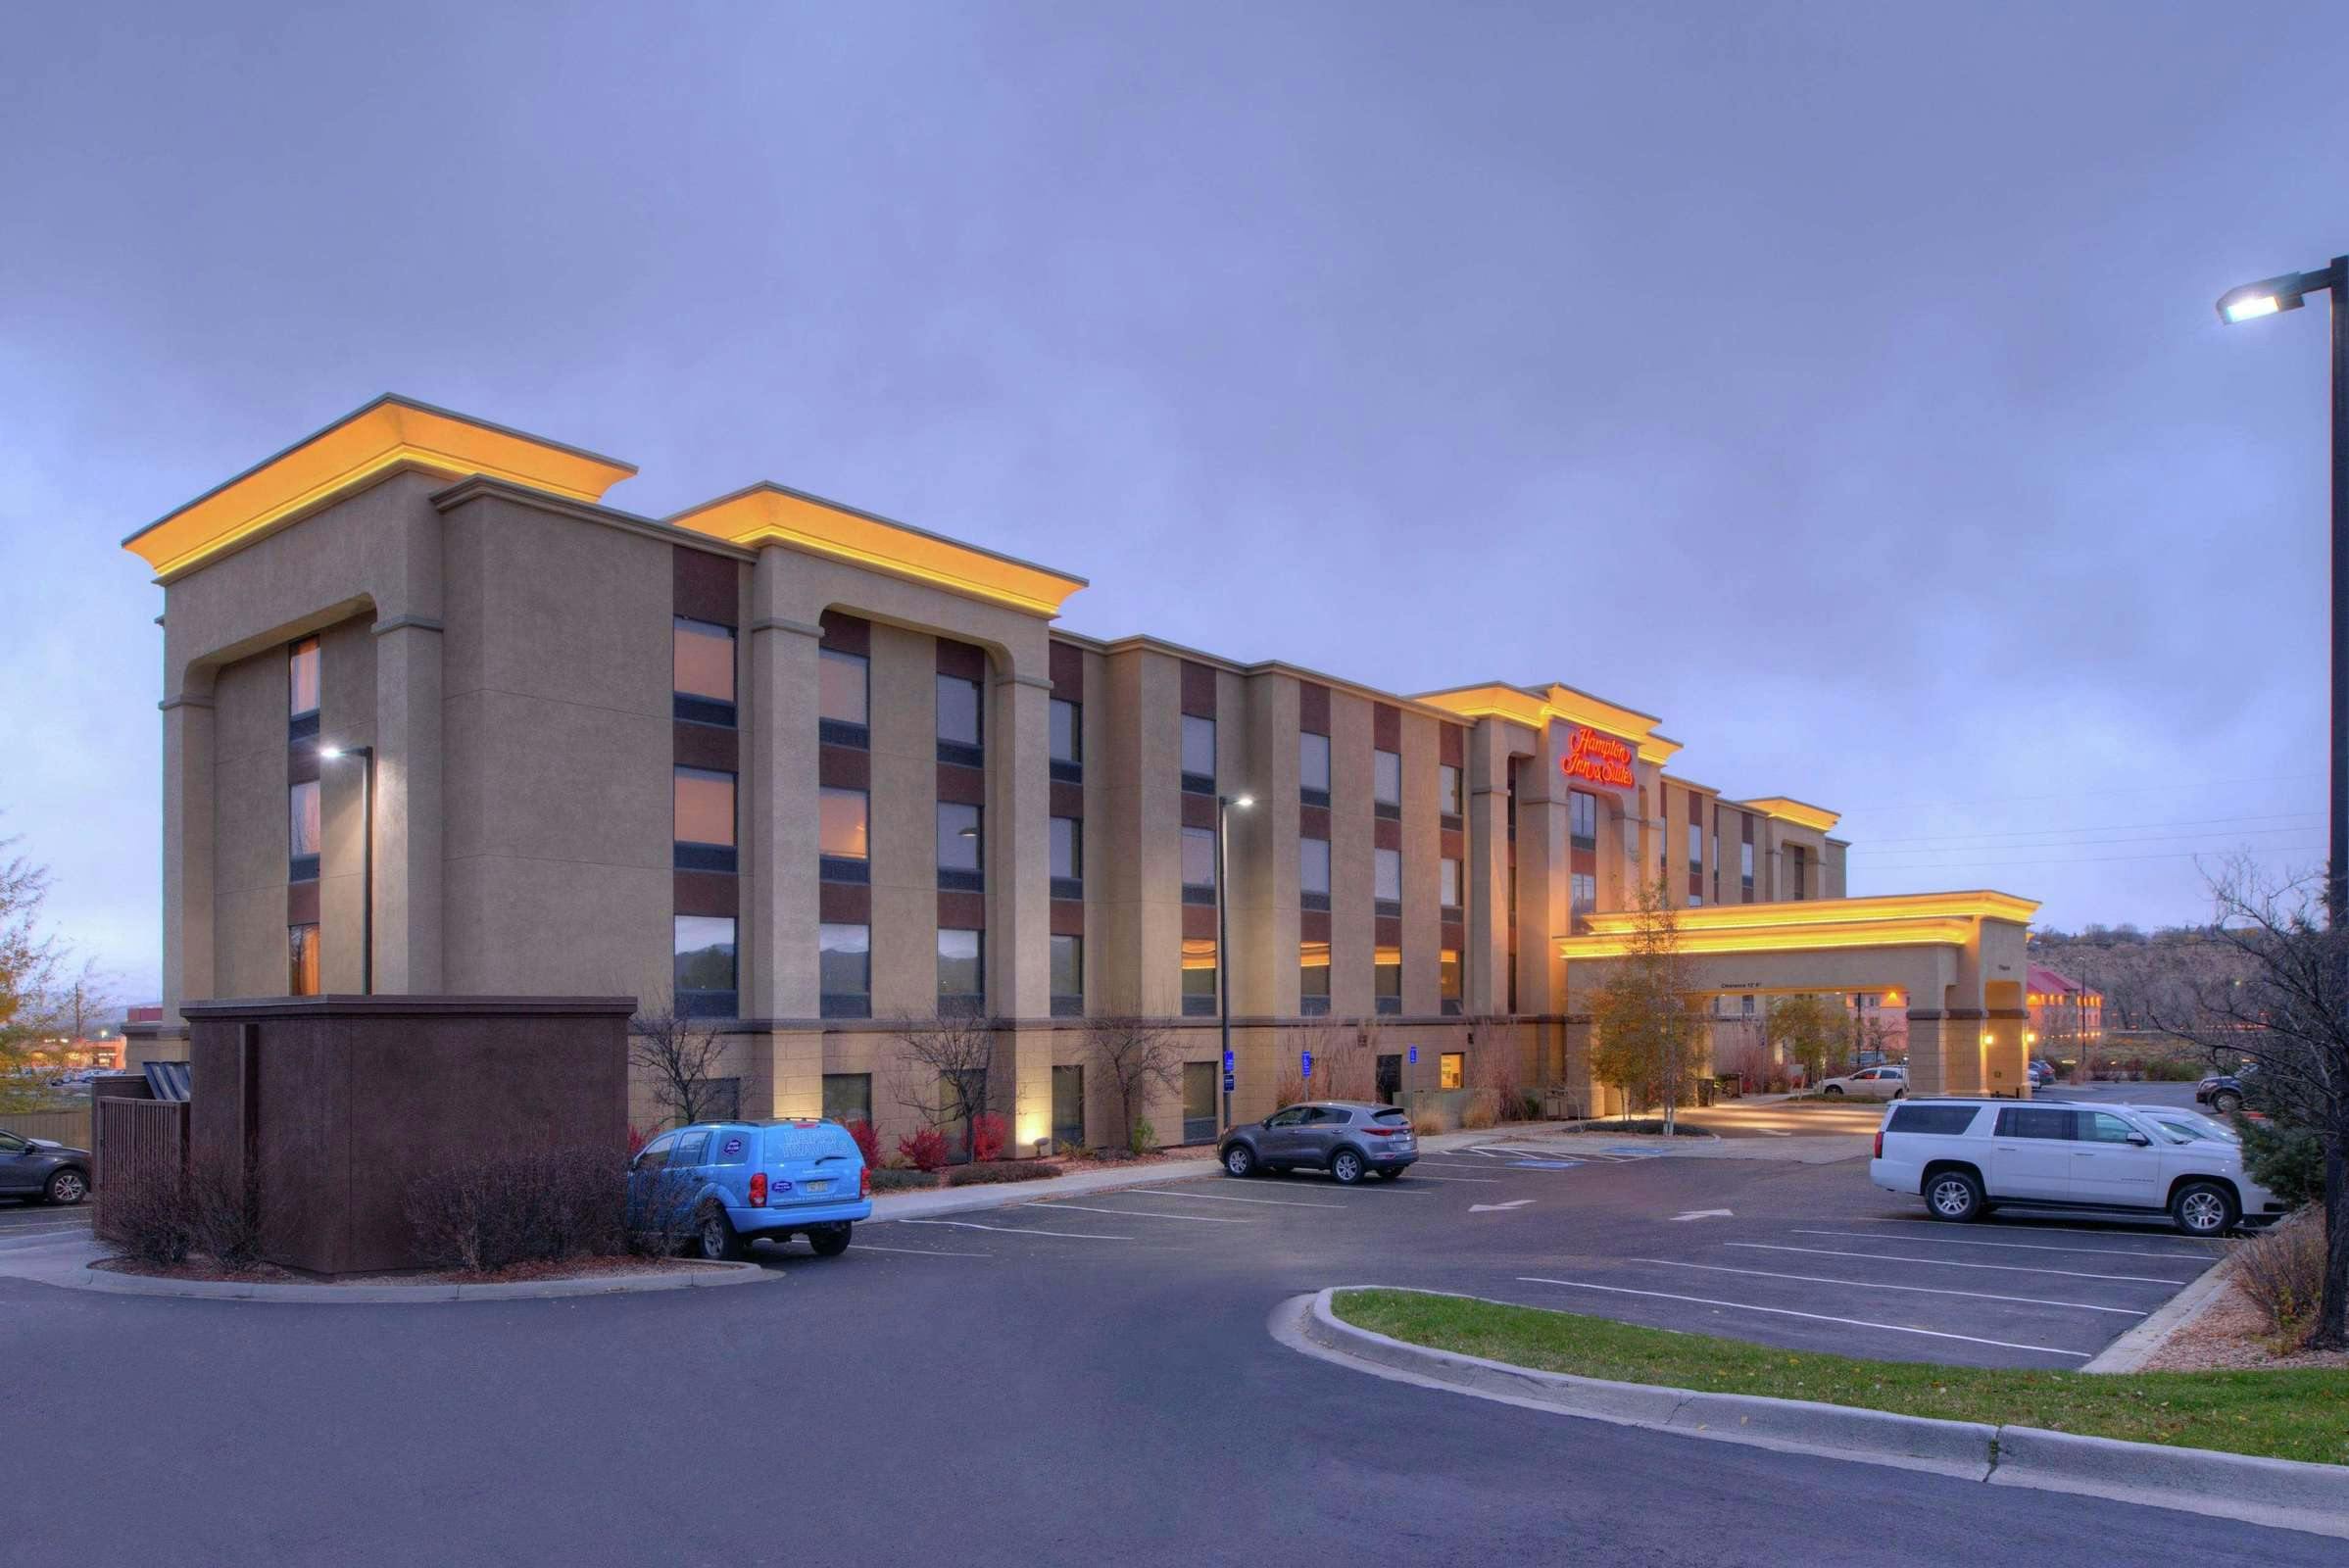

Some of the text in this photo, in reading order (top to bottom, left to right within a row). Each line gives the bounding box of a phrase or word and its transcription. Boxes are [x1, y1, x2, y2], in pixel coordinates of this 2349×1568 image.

[1570, 727, 1632, 764] Hampton
[1562, 752, 1594, 779] Inn
[1602, 762, 1635, 787] Suites
